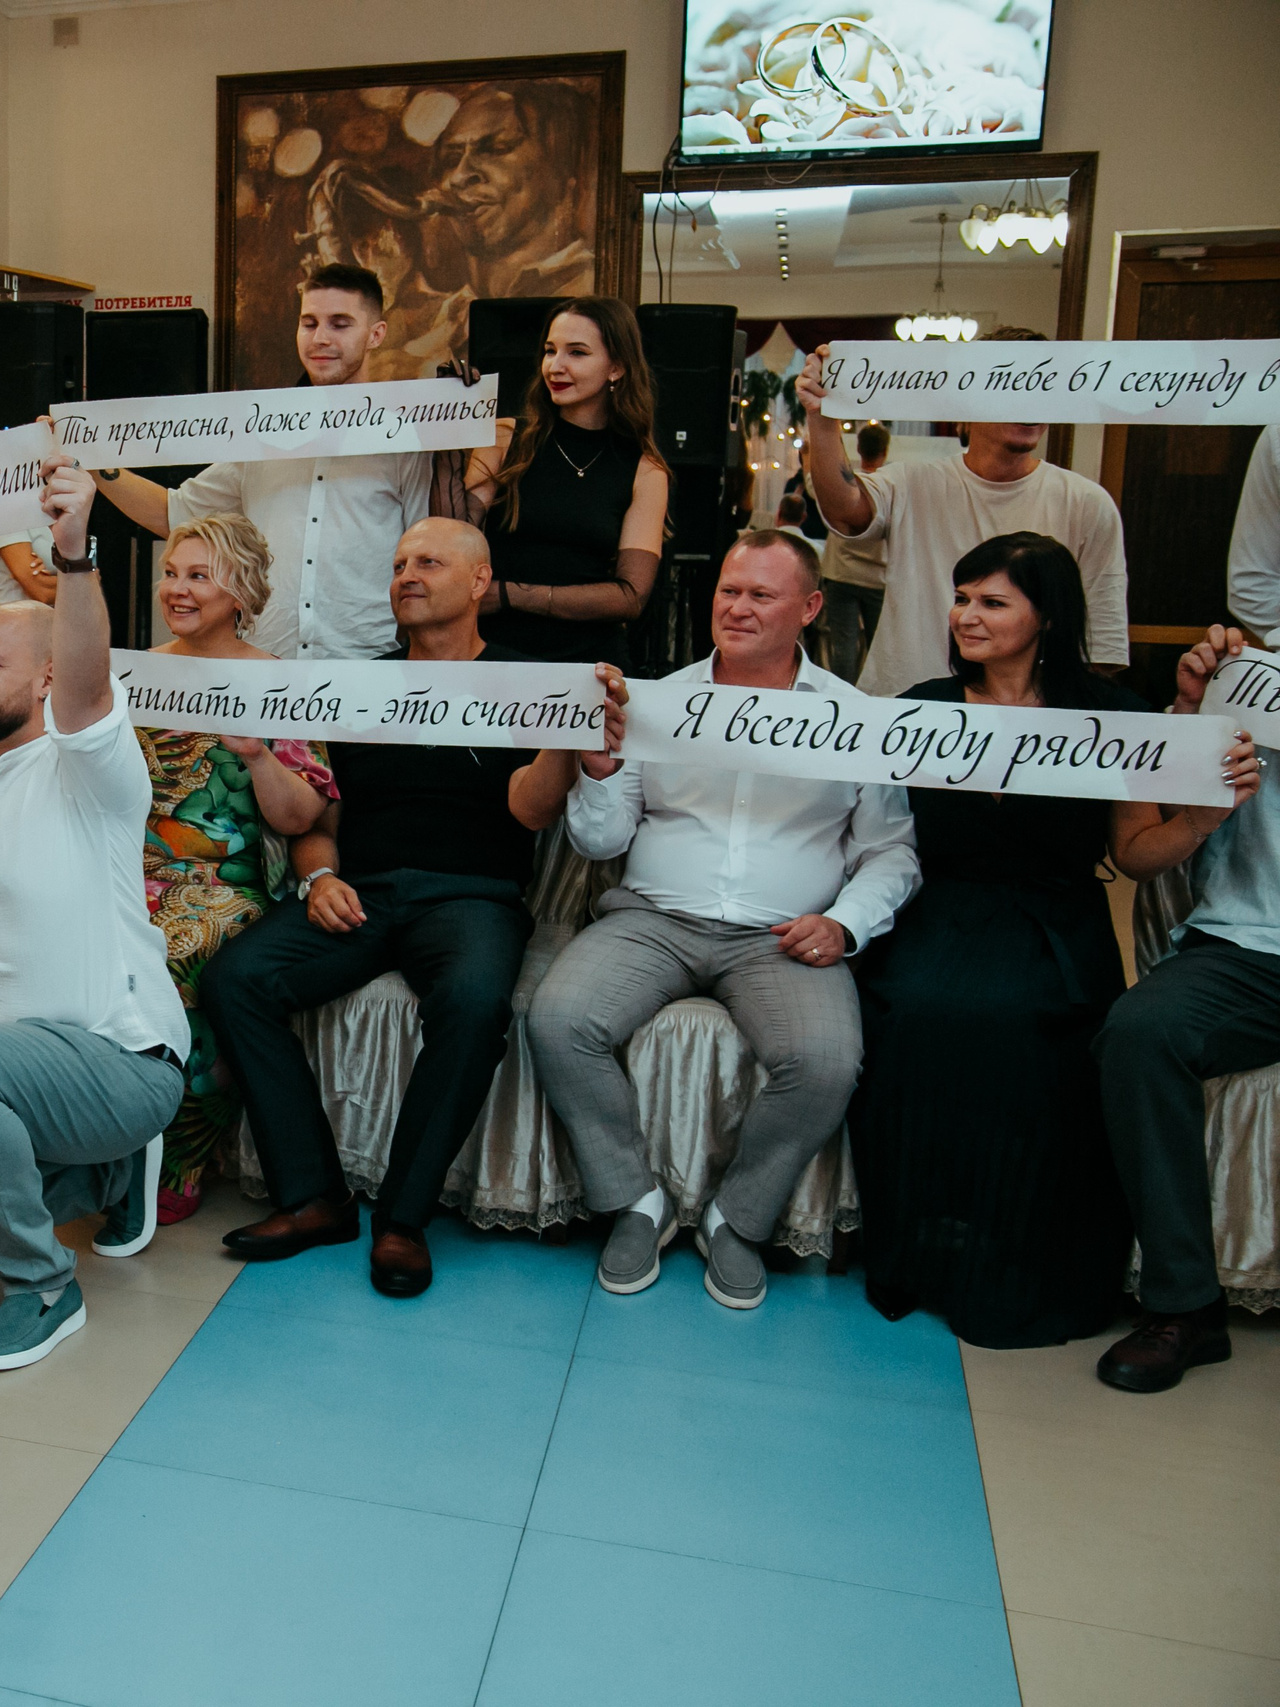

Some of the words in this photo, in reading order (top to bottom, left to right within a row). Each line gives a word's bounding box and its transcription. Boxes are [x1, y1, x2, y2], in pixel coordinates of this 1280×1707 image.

[94, 295, 193, 310] ПОТРЕБИТЕЛЯ
[821, 356, 845, 390] Я
[850, 357, 948, 404] думаю
[957, 370, 976, 391] о
[984, 357, 1058, 391] тебе
[1068, 360, 1112, 392] 61
[1119, 358, 1248, 408] секунду
[52, 415, 99, 445] Ты
[107, 416, 234, 456] прекрасна,
[244, 403, 312, 433] даже
[319, 396, 385, 429] когда
[386, 398, 498, 439] злишься
[119, 669, 246, 719] нимать
[260, 679, 342, 722] тебя
[380, 686, 449, 725] это
[462, 689, 604, 730] счастье
[673, 691, 715, 739] Я
[724, 695, 864, 753] всегда
[880, 703, 994, 785] буду
[1000, 716, 1168, 789] рядом
